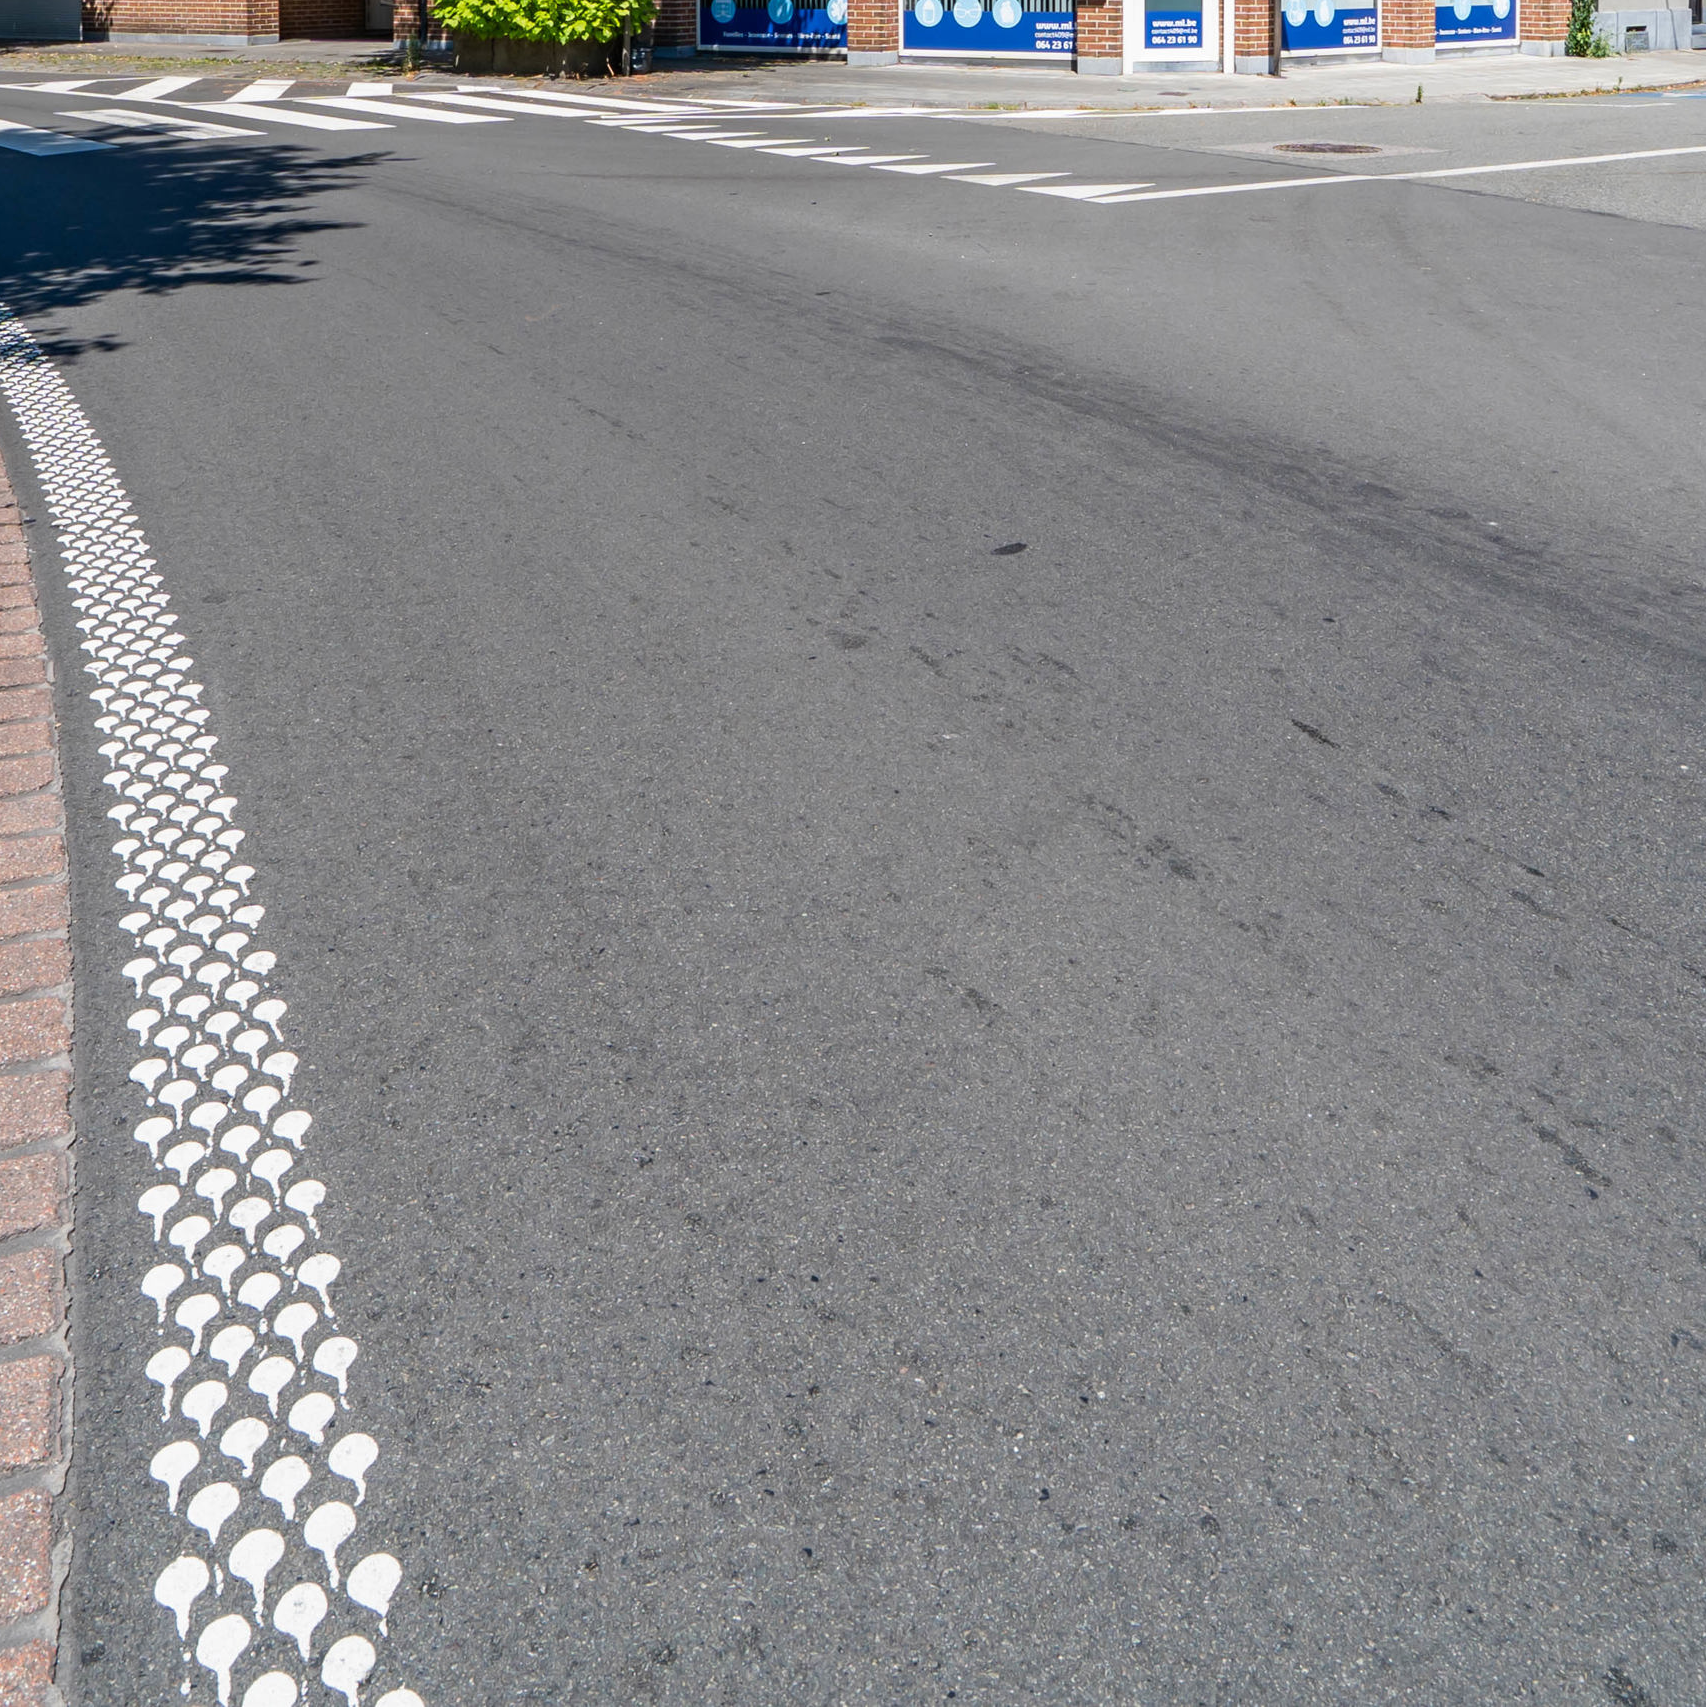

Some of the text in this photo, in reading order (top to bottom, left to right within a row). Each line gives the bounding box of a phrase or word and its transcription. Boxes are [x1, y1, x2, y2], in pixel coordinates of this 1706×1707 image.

[1151, 34, 1198, 45] 064 23 61 90
[1035, 40, 1073, 50] 064 23 61
